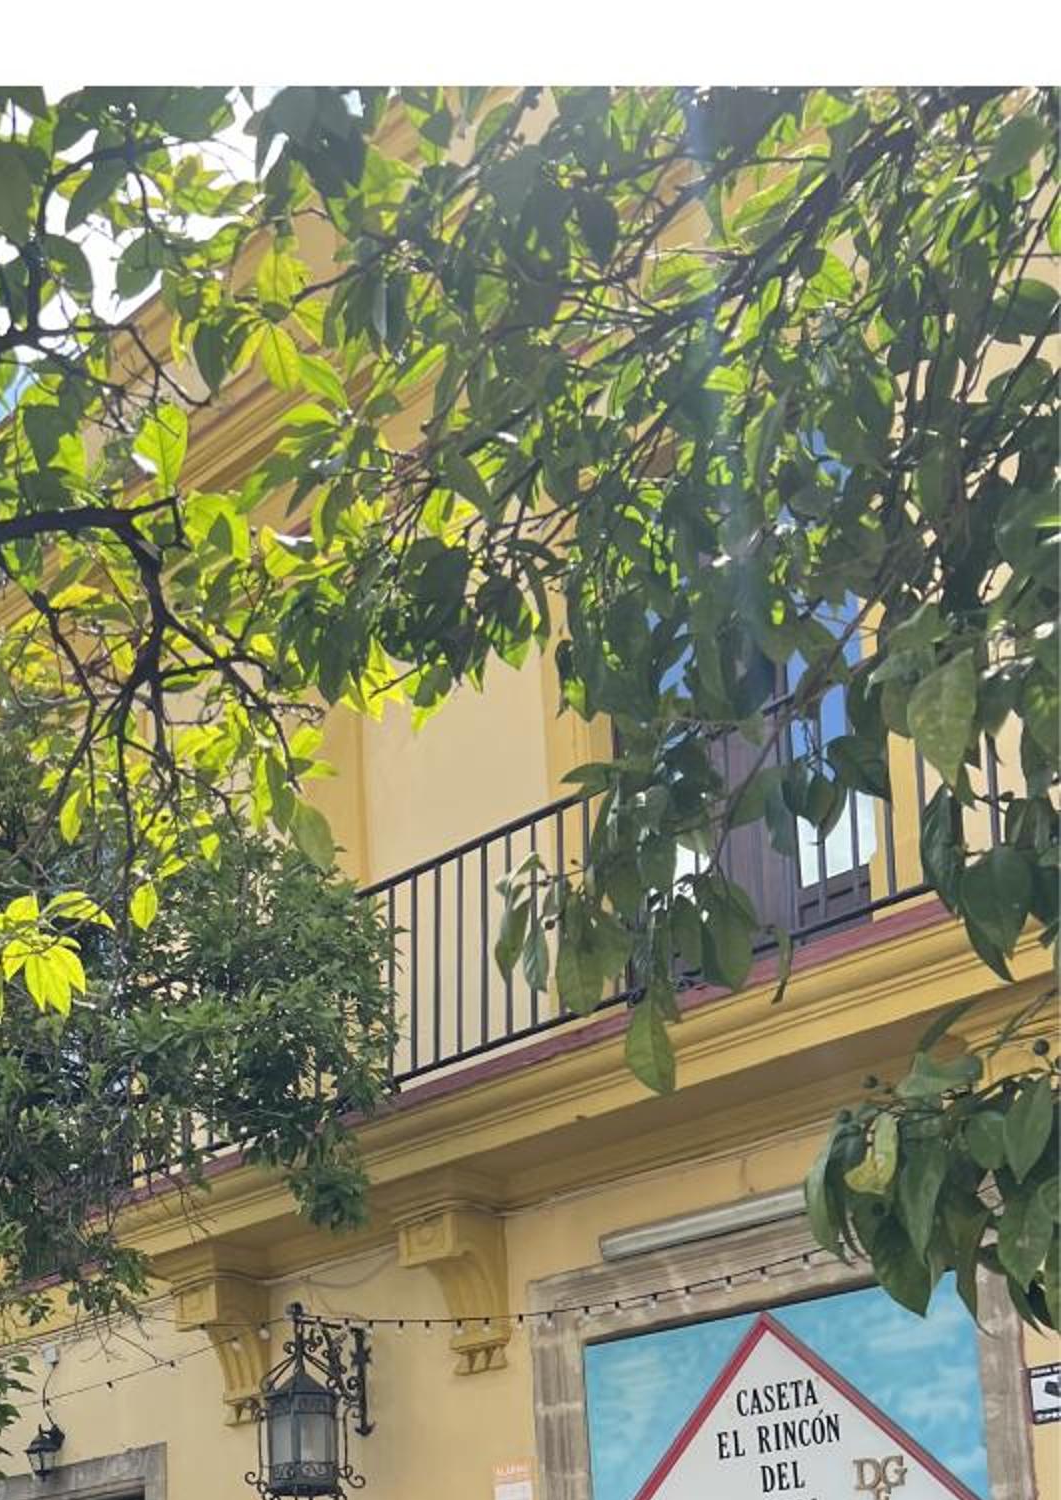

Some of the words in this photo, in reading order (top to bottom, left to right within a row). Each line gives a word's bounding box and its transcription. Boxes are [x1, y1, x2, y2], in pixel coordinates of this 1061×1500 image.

[736, 1379, 819, 1417] CASETA
[716, 1430, 746, 1460] EL
[757, 1409, 840, 1454] RINCÓN
[760, 1460, 805, 1493] DEL
